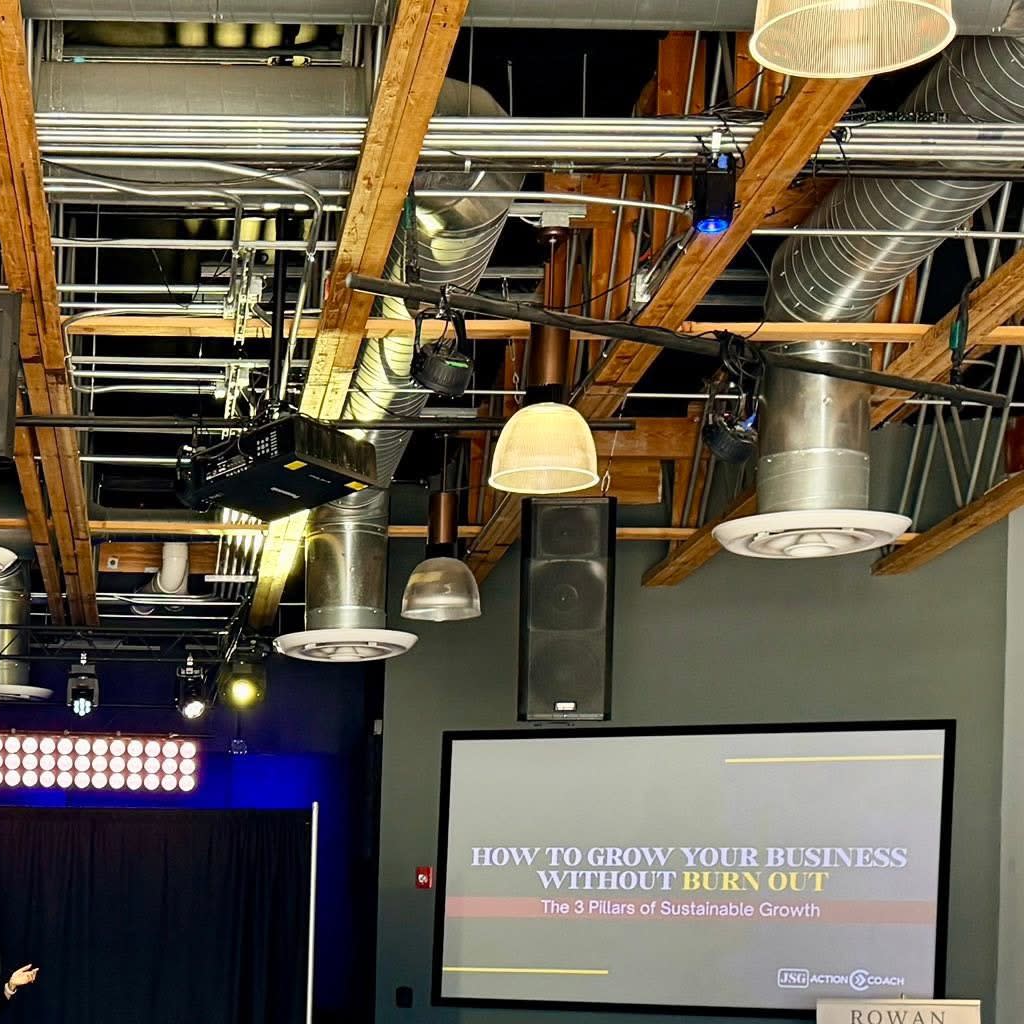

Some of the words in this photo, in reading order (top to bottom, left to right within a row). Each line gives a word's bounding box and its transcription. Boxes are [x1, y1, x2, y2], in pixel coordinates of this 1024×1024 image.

[471, 847, 541, 866] HOW
[545, 847, 582, 866] TO
[587, 847, 676, 867] GROW
[680, 847, 758, 868] YOUR
[765, 847, 908, 868] BUSINESS
[536, 870, 677, 890] WITHOUT
[682, 871, 762, 891] BURN
[768, 871, 830, 892] OUT
[541, 900, 570, 914] The
[574, 901, 585, 914] 3
[588, 900, 635, 914] Pillars
[640, 901, 656, 915] of
[660, 901, 755, 916] Sustainable
[759, 902, 821, 918] Growth
[780, 971, 807, 985] JSG
[810, 975, 848, 985] ACTION
